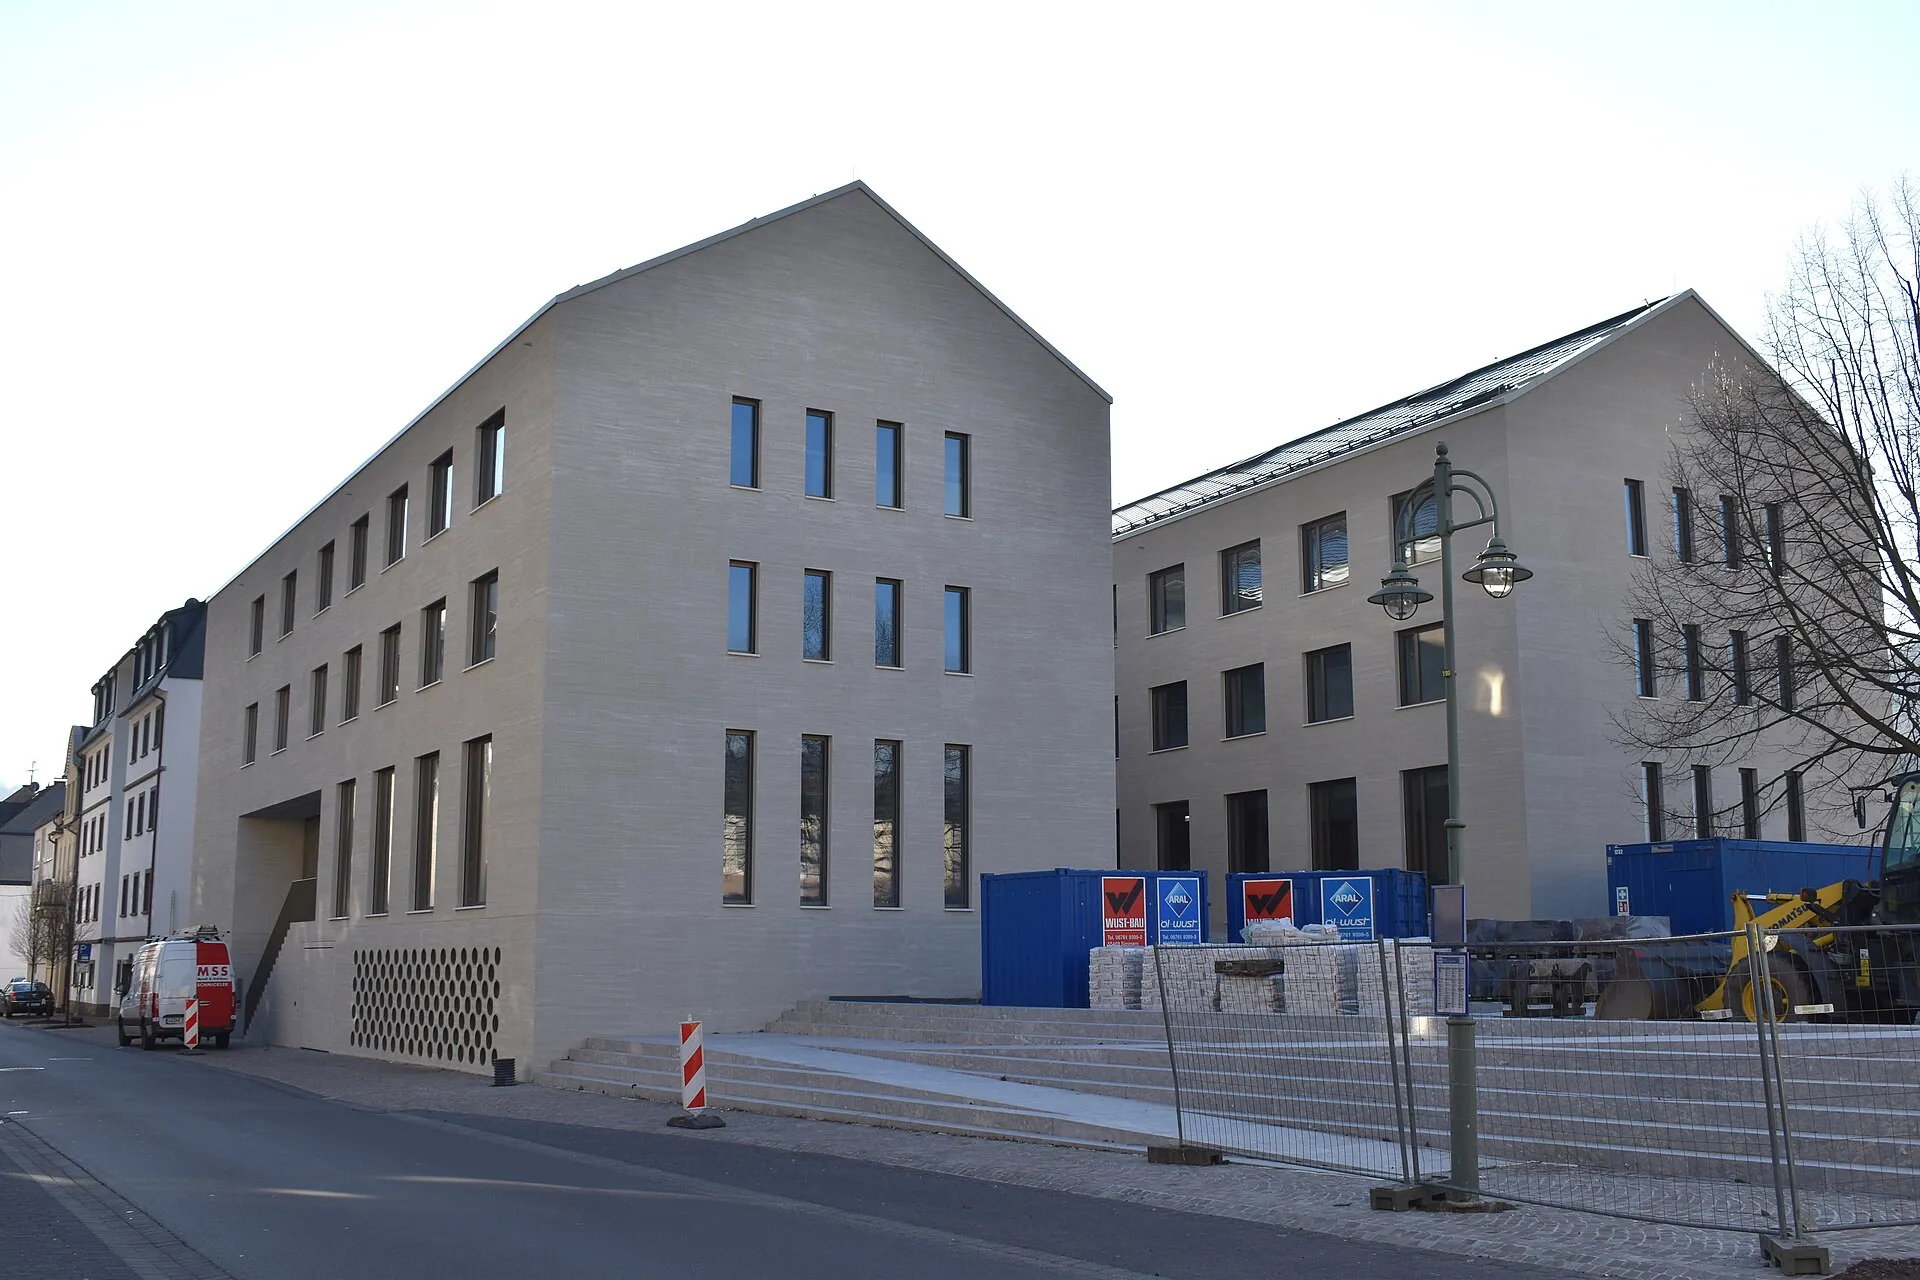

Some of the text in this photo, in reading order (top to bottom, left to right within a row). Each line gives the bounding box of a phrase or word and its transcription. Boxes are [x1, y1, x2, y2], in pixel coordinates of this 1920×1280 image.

[1168, 895, 1189, 904] ARAL
[1334, 894, 1359, 903] ARAL
[1767, 902, 1810, 930] OMATSU
[1105, 917, 1144, 928] WUST-BAU
[197, 966, 228, 976] MSS
